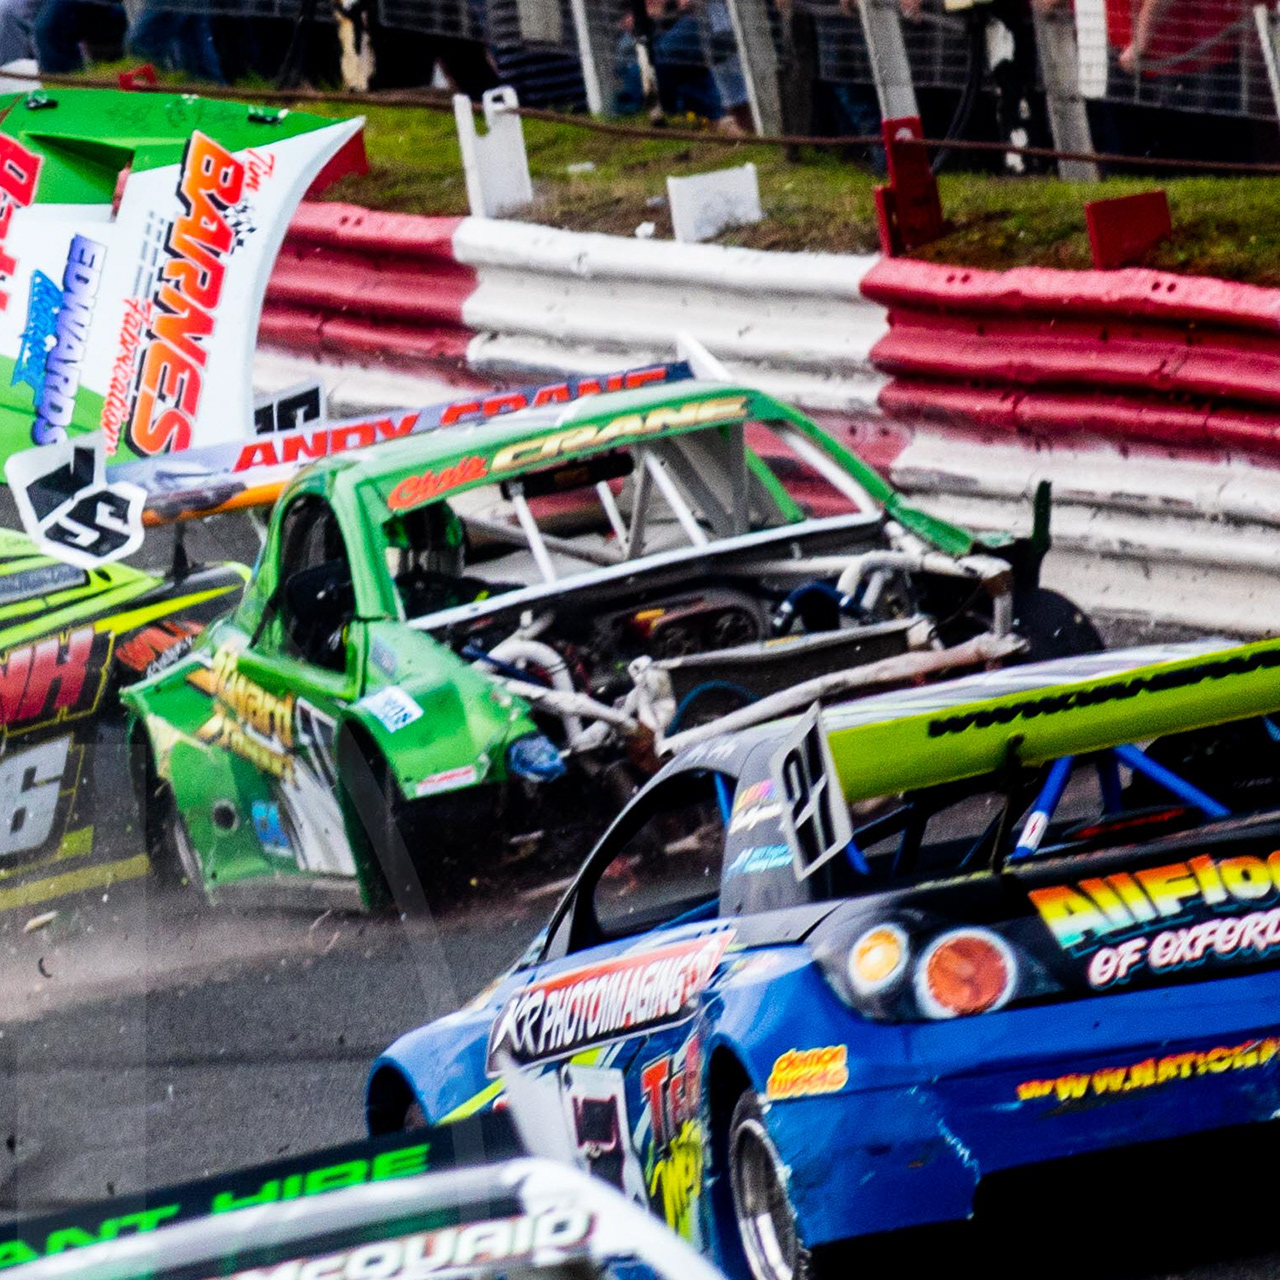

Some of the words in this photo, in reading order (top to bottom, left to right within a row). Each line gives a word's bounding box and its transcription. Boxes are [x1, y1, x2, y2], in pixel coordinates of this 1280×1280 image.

[32, 234, 108, 445] EDWARDS
[130, 129, 244, 455] BARNES
[232, 413, 421, 472] ANDY
[1088, 936, 1149, 987] OF
